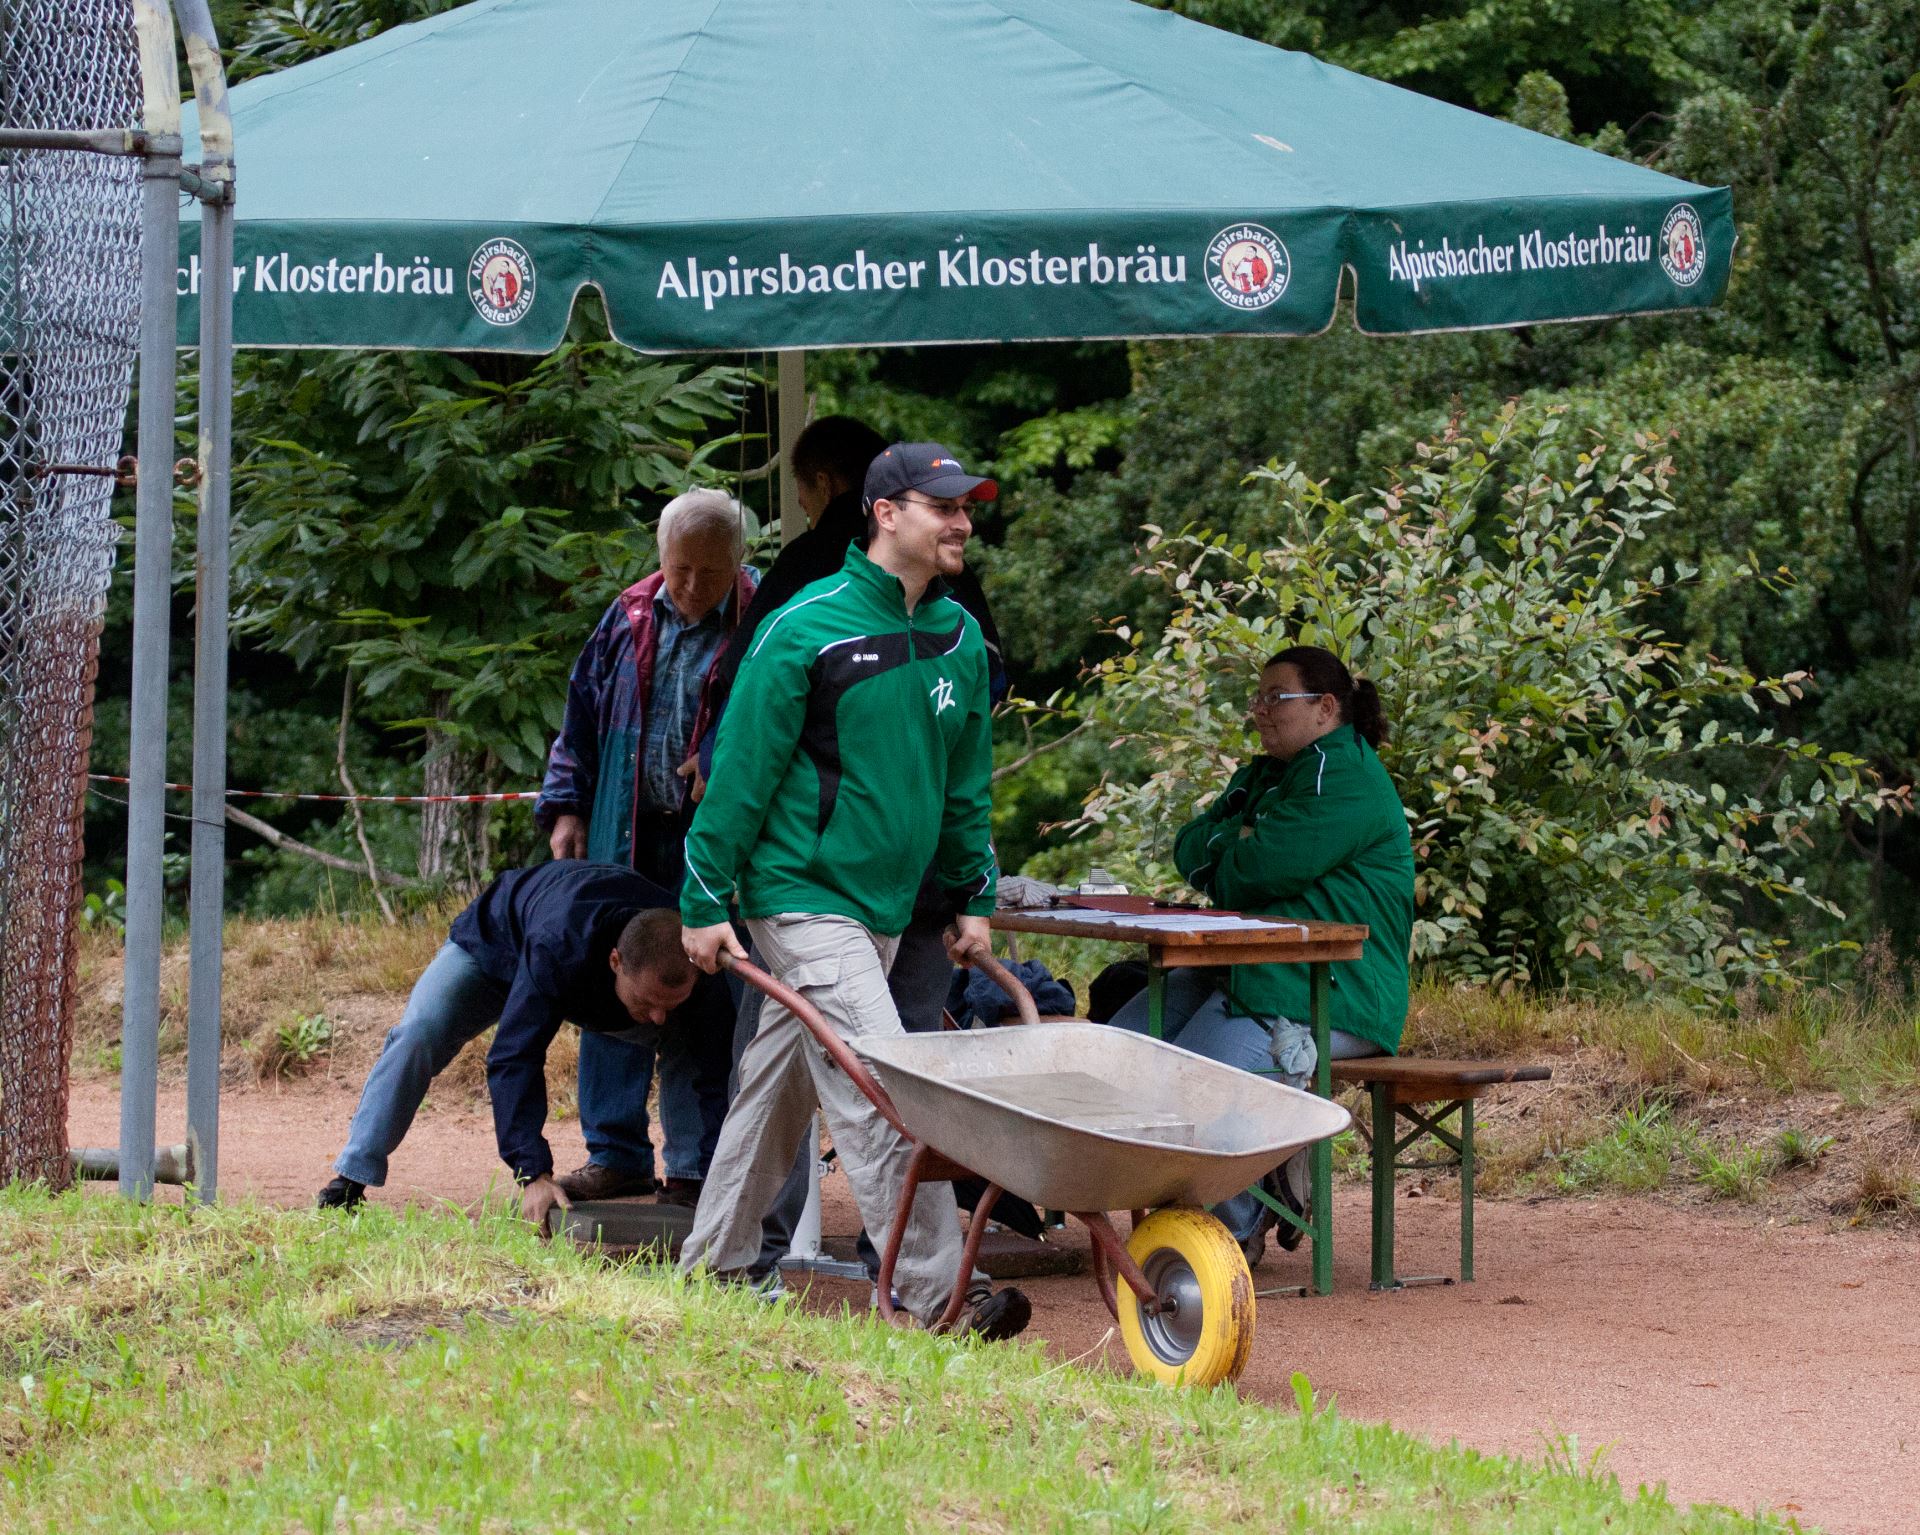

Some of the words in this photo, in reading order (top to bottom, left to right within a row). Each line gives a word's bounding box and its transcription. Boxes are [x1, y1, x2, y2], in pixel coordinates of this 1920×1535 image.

[1662, 206, 1701, 245] Alpirsbacher
[471, 241, 531, 280] Alpirsbacher
[1209, 227, 1283, 267] Alpirsbacher
[1389, 235, 1514, 292] Alpirsbacher
[1518, 225, 1651, 270] Klosterbräu
[1661, 250, 1703, 283] Klosterbräu
[254, 252, 454, 294] Klosterbräu
[656, 250, 926, 309] Alpirsbacher
[939, 244, 1186, 287] Klosterbräu
[1210, 273, 1285, 306] Klosterbräu
[472, 289, 532, 322] Klosterbräu
